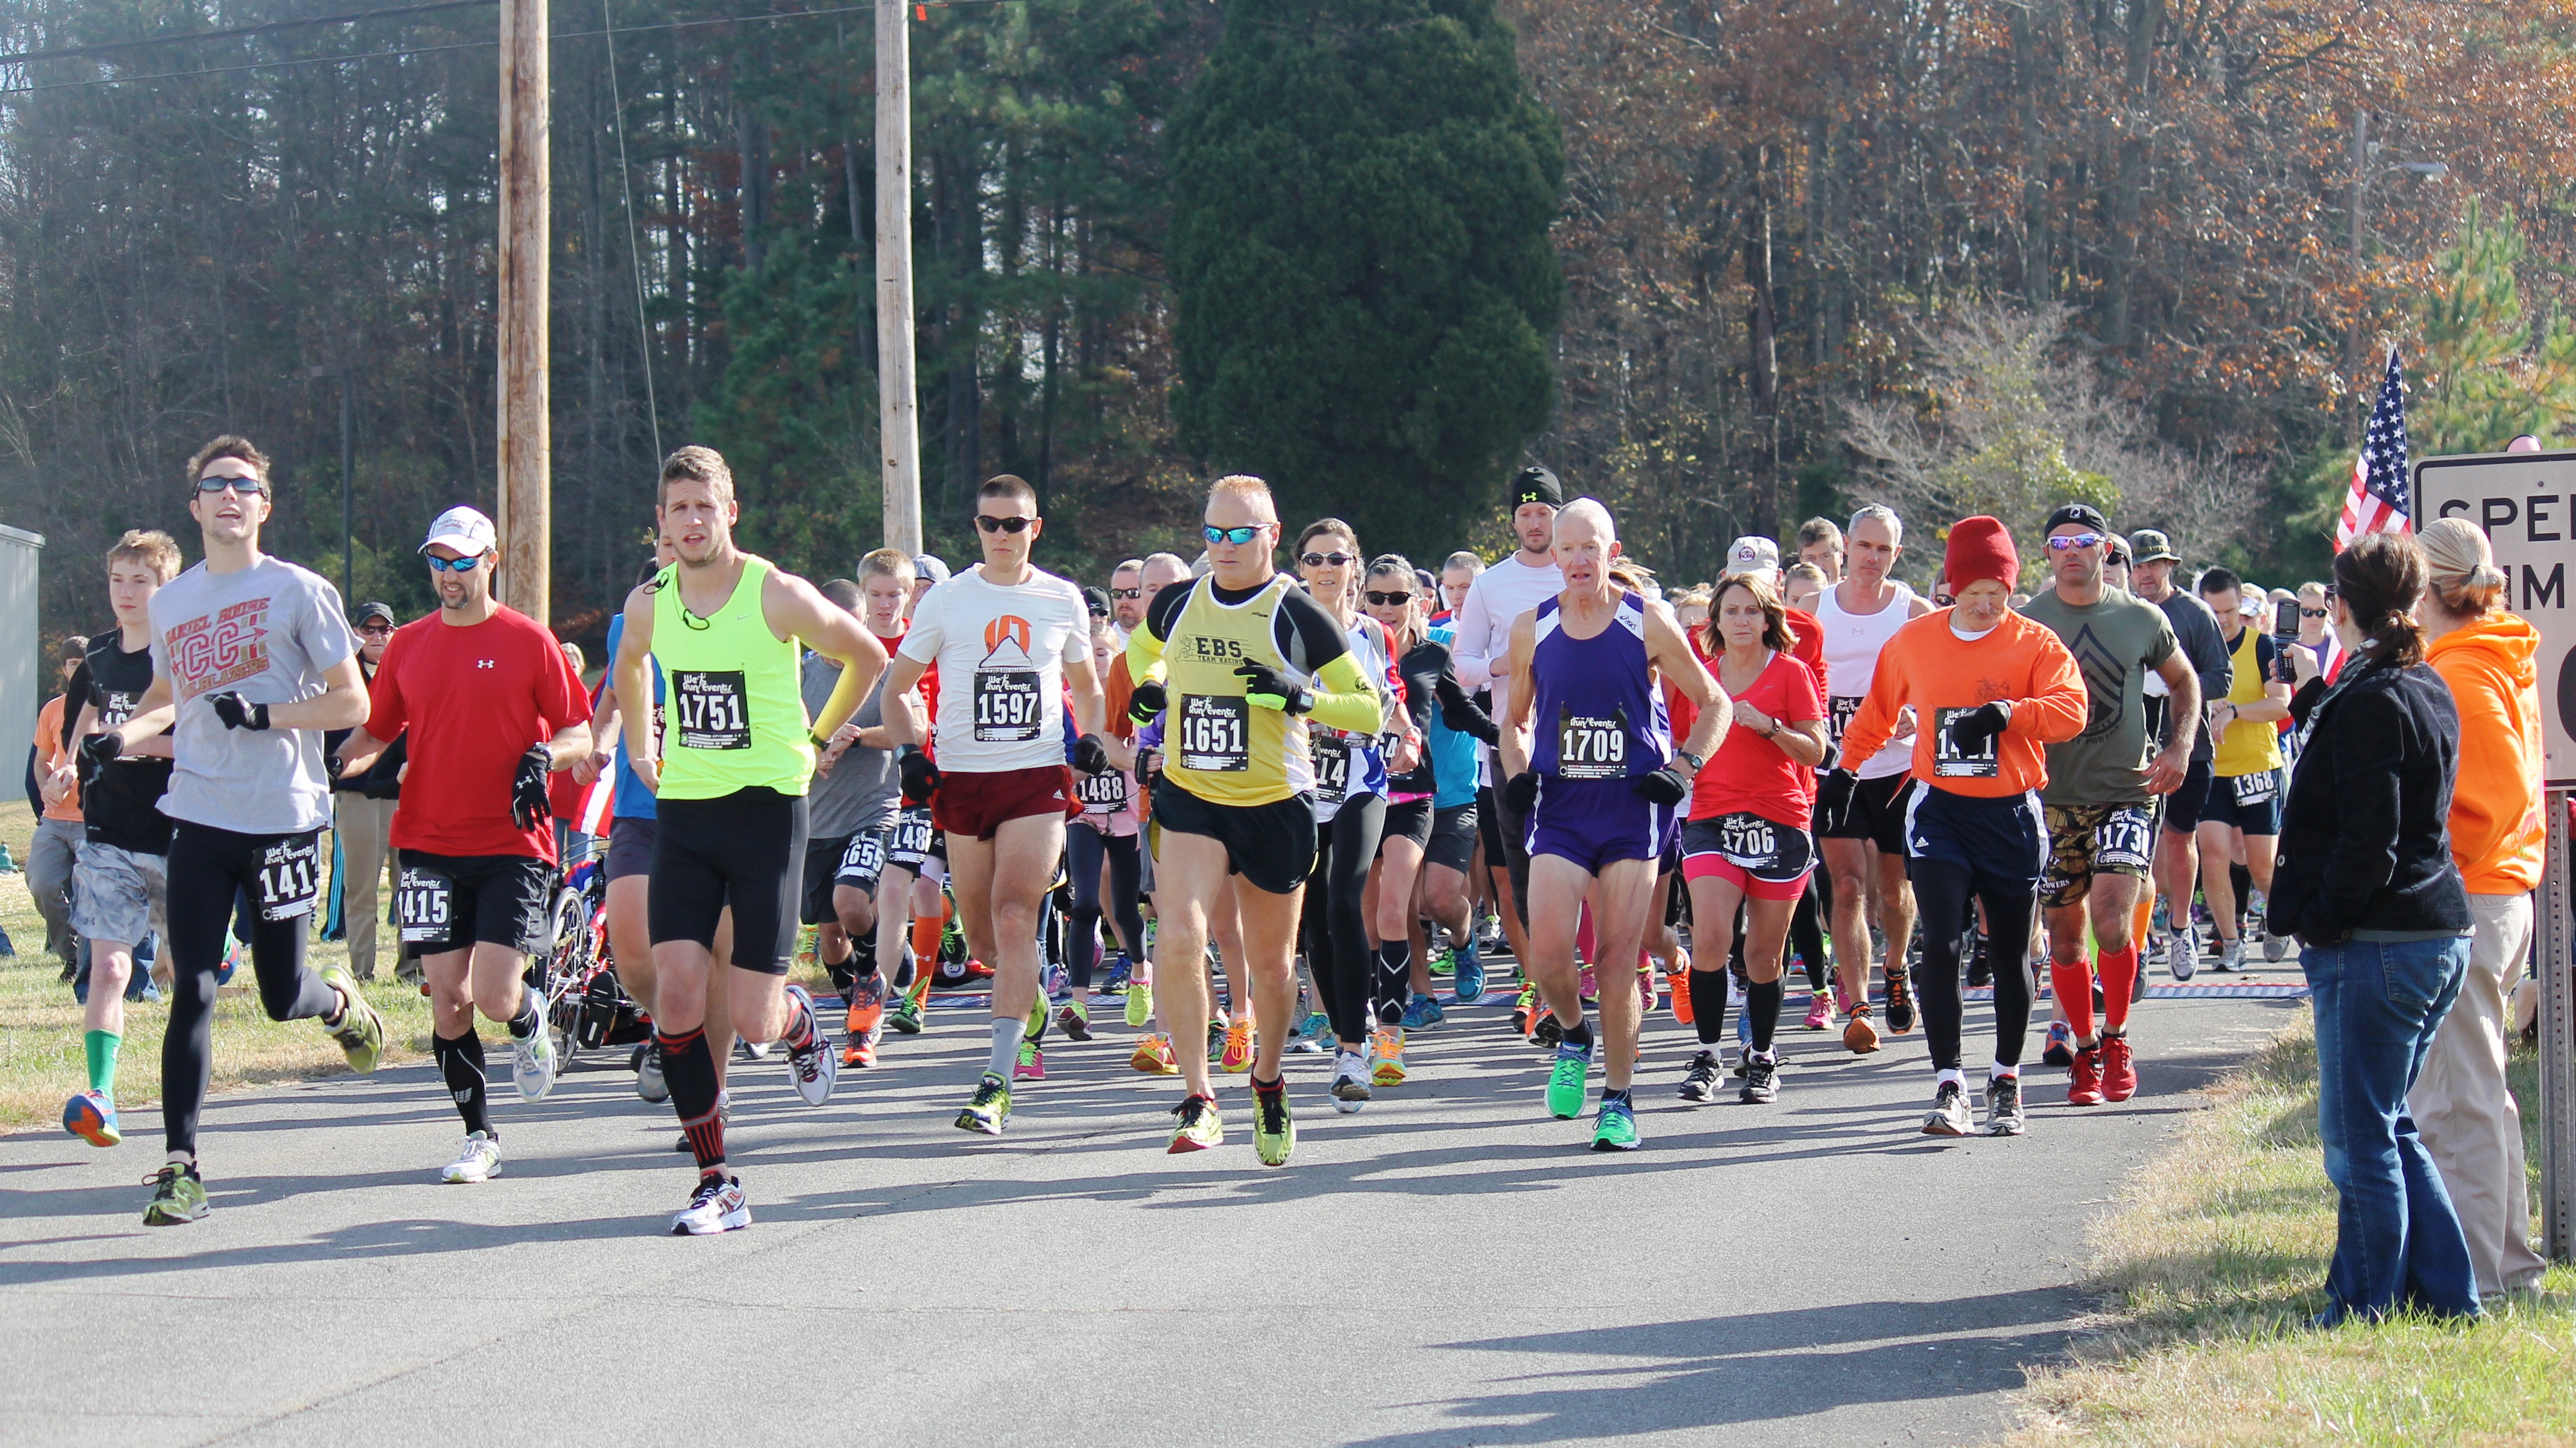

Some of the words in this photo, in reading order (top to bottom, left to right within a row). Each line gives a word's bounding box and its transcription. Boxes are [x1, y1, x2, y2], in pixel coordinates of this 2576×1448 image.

[1196, 637, 1242, 657] EBS
[684, 674, 698, 684] We
[985, 682, 1003, 692] Run
[1005, 683, 1031, 692] Events
[988, 675, 1003, 684] We
[682, 683, 701, 694] Run
[702, 683, 733, 694] Events
[109, 700, 123, 712] Run
[979, 693, 1038, 724] 1597
[1191, 698, 1204, 707] We
[1836, 704, 1849, 713] Run
[680, 694, 744, 730] 1751
[1189, 705, 1205, 716] Run
[1207, 707, 1236, 718] Events
[1570, 718, 1586, 729] Run
[1588, 719, 1617, 729] Events
[1183, 717, 1243, 753] 1651
[1562, 729, 1624, 762] 1709
[1079, 777, 1123, 801] 1488
[2233, 770, 2274, 797] 1368
[1723, 823, 1740, 832] Run
[1741, 820, 1766, 829] Events
[1721, 827, 1775, 855] 1706
[2103, 823, 2150, 858] 1730
[265, 854, 285, 865] Run
[286, 844, 315, 860] Events
[266, 847, 283, 858] We
[839, 843, 885, 872] 1655
[412, 879, 441, 890] Events
[398, 890, 449, 924] 1415
